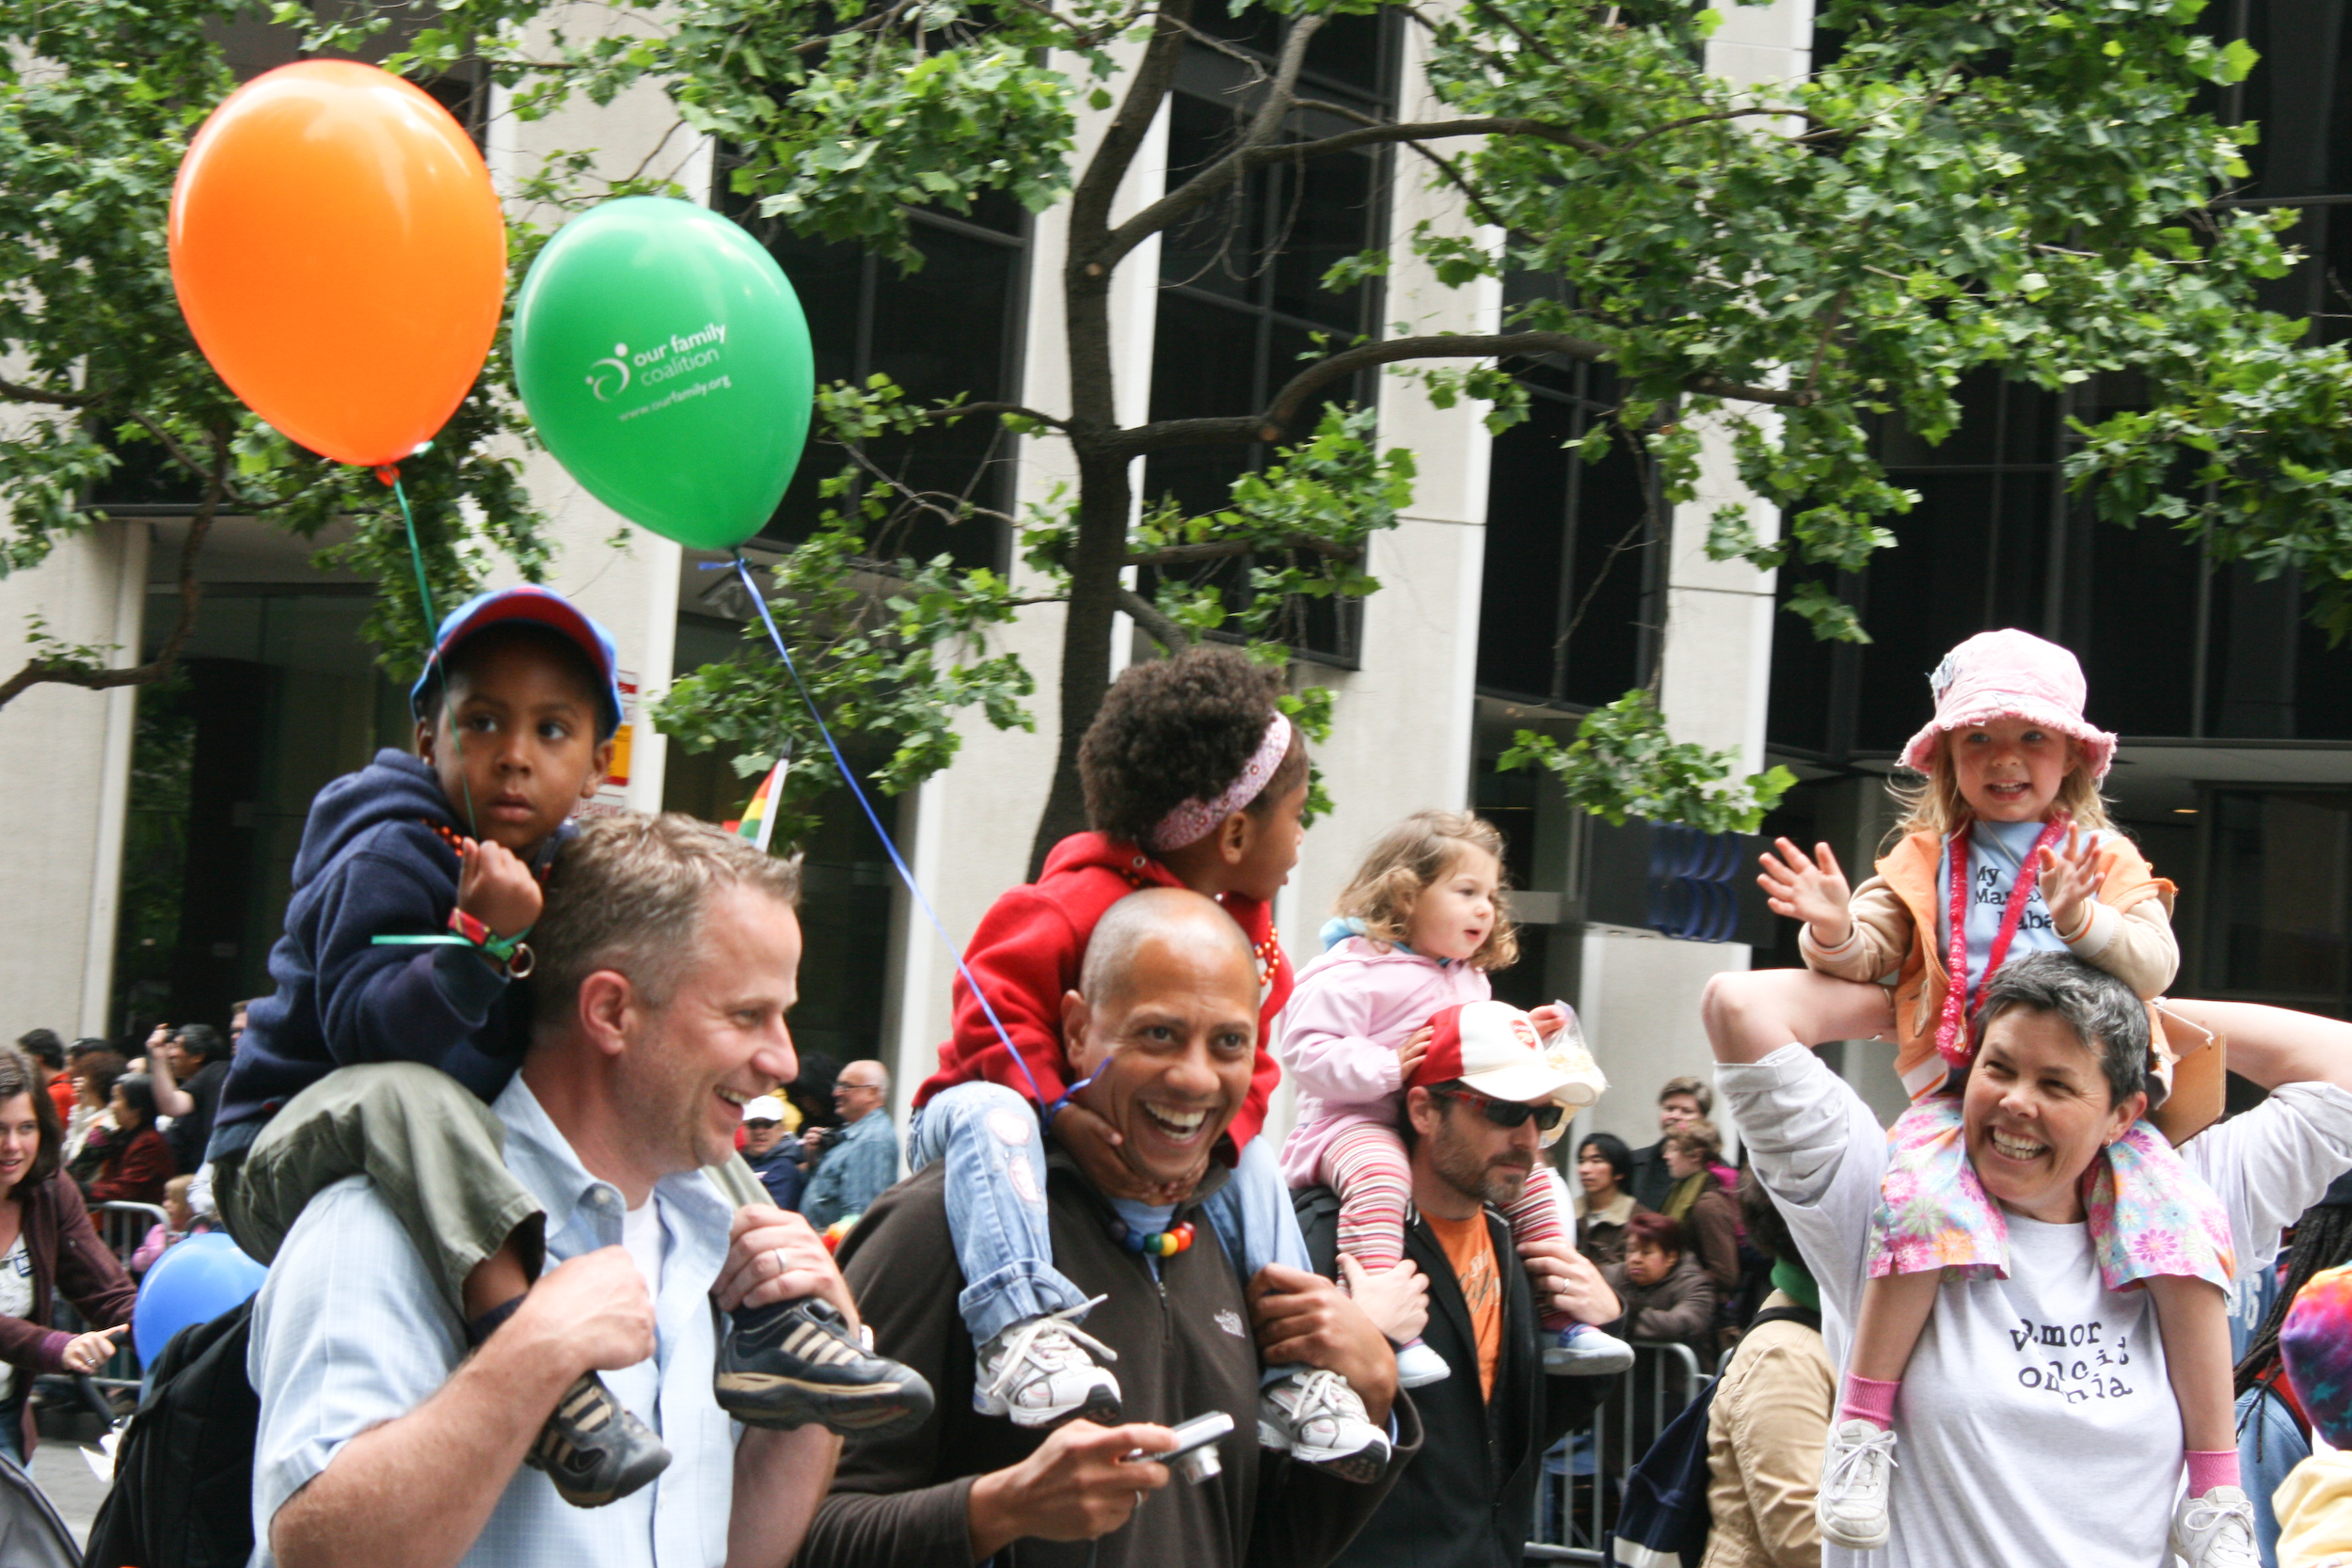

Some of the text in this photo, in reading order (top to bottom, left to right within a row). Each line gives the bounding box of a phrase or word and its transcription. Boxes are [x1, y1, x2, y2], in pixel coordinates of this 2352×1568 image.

[633, 323, 726, 367] our family
[641, 348, 721, 386] coalition
[1977, 865, 2000, 887] My
